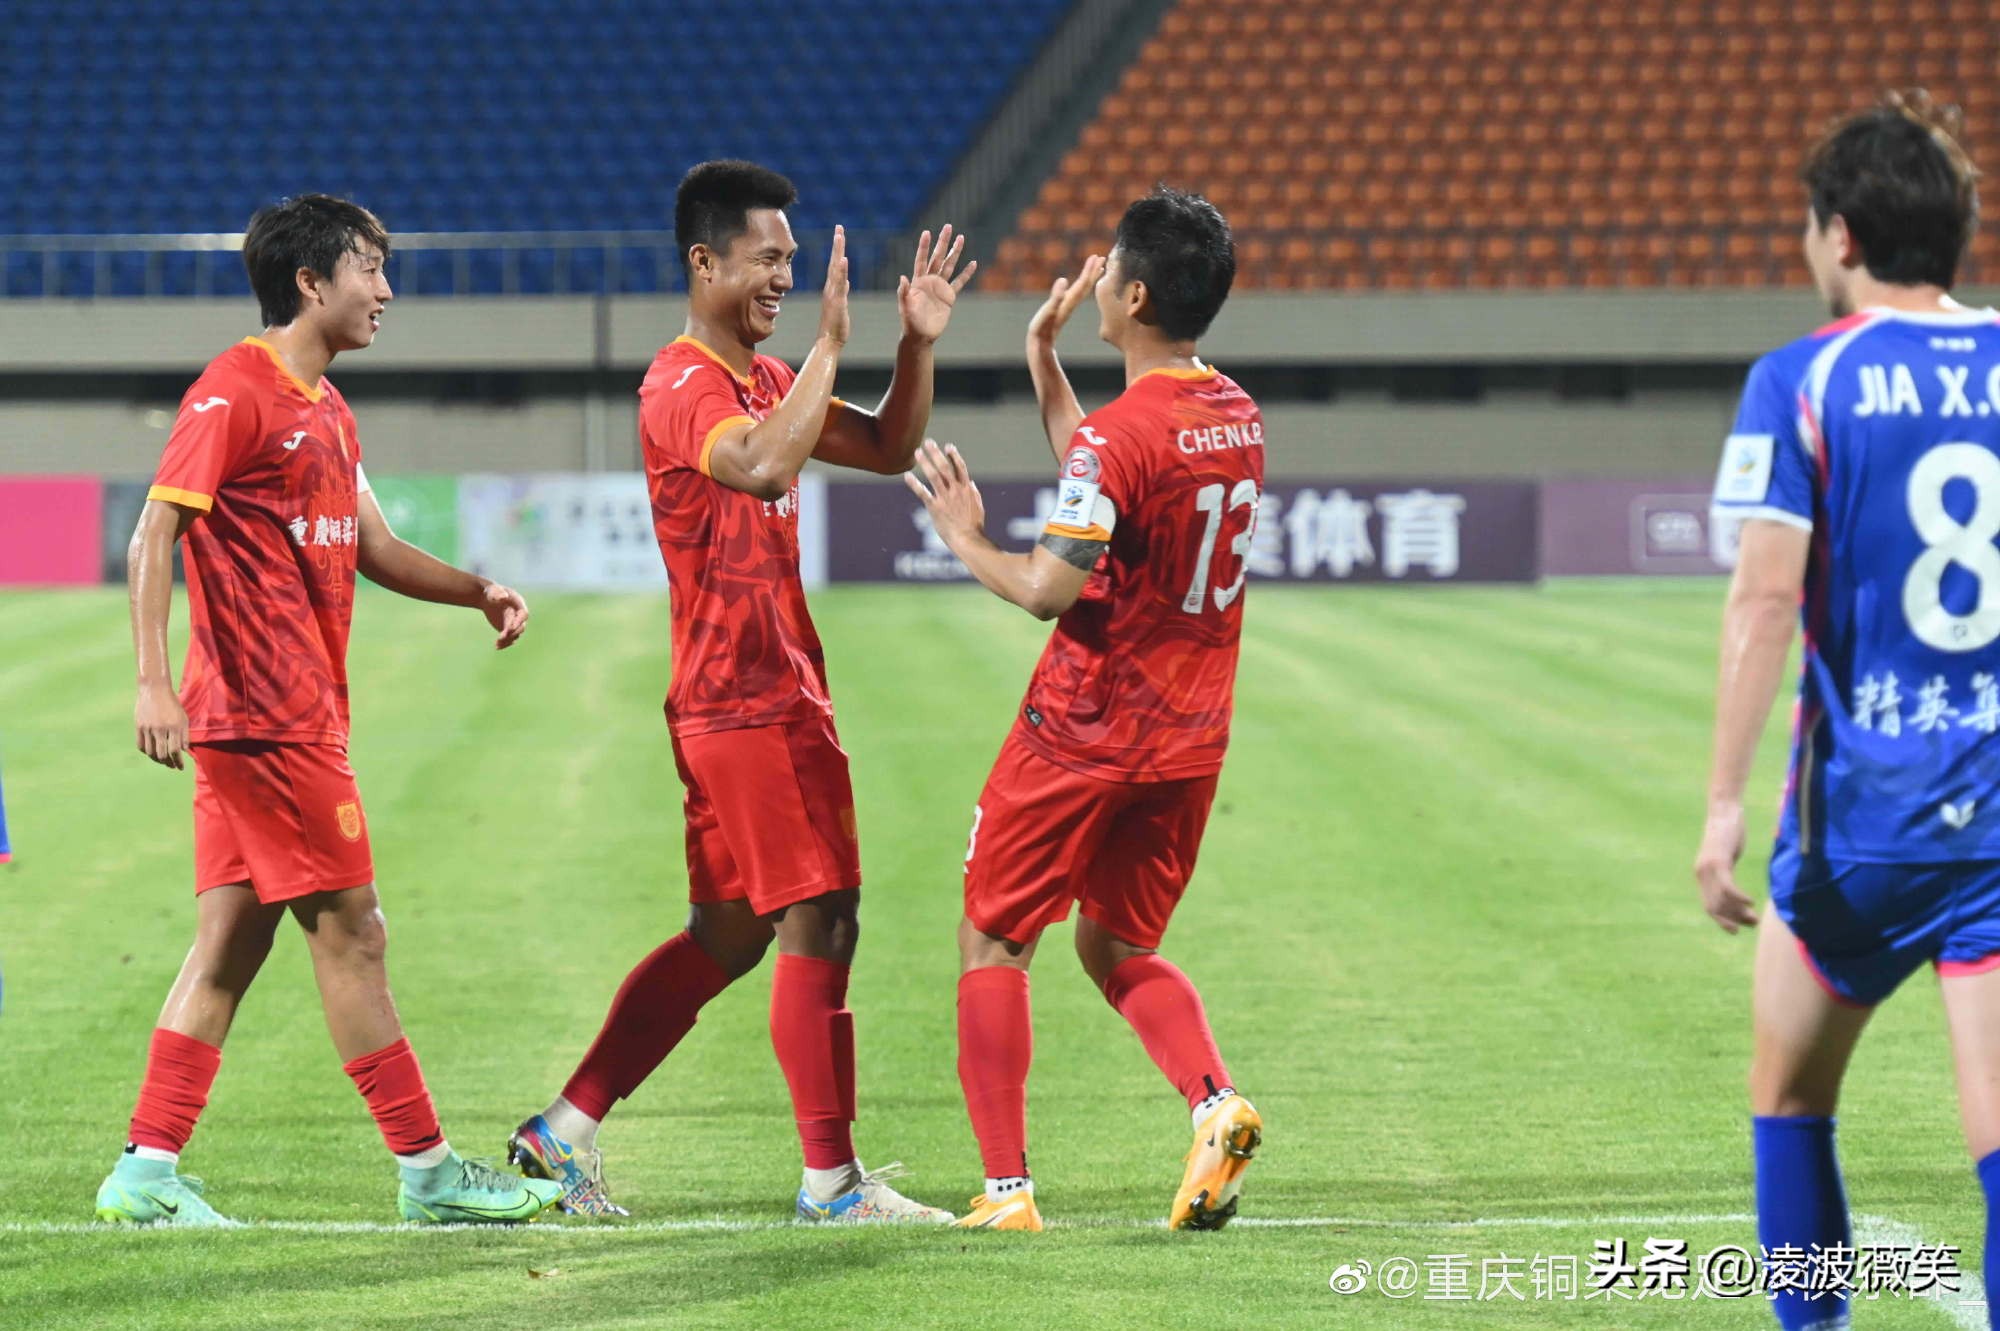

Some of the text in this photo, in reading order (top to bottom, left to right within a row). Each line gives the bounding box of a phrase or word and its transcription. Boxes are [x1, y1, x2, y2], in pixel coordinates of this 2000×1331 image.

[1853, 364, 1923, 417] JIA
[1182, 479, 1258, 613] 13
[1904, 441, 2000, 651] 8
